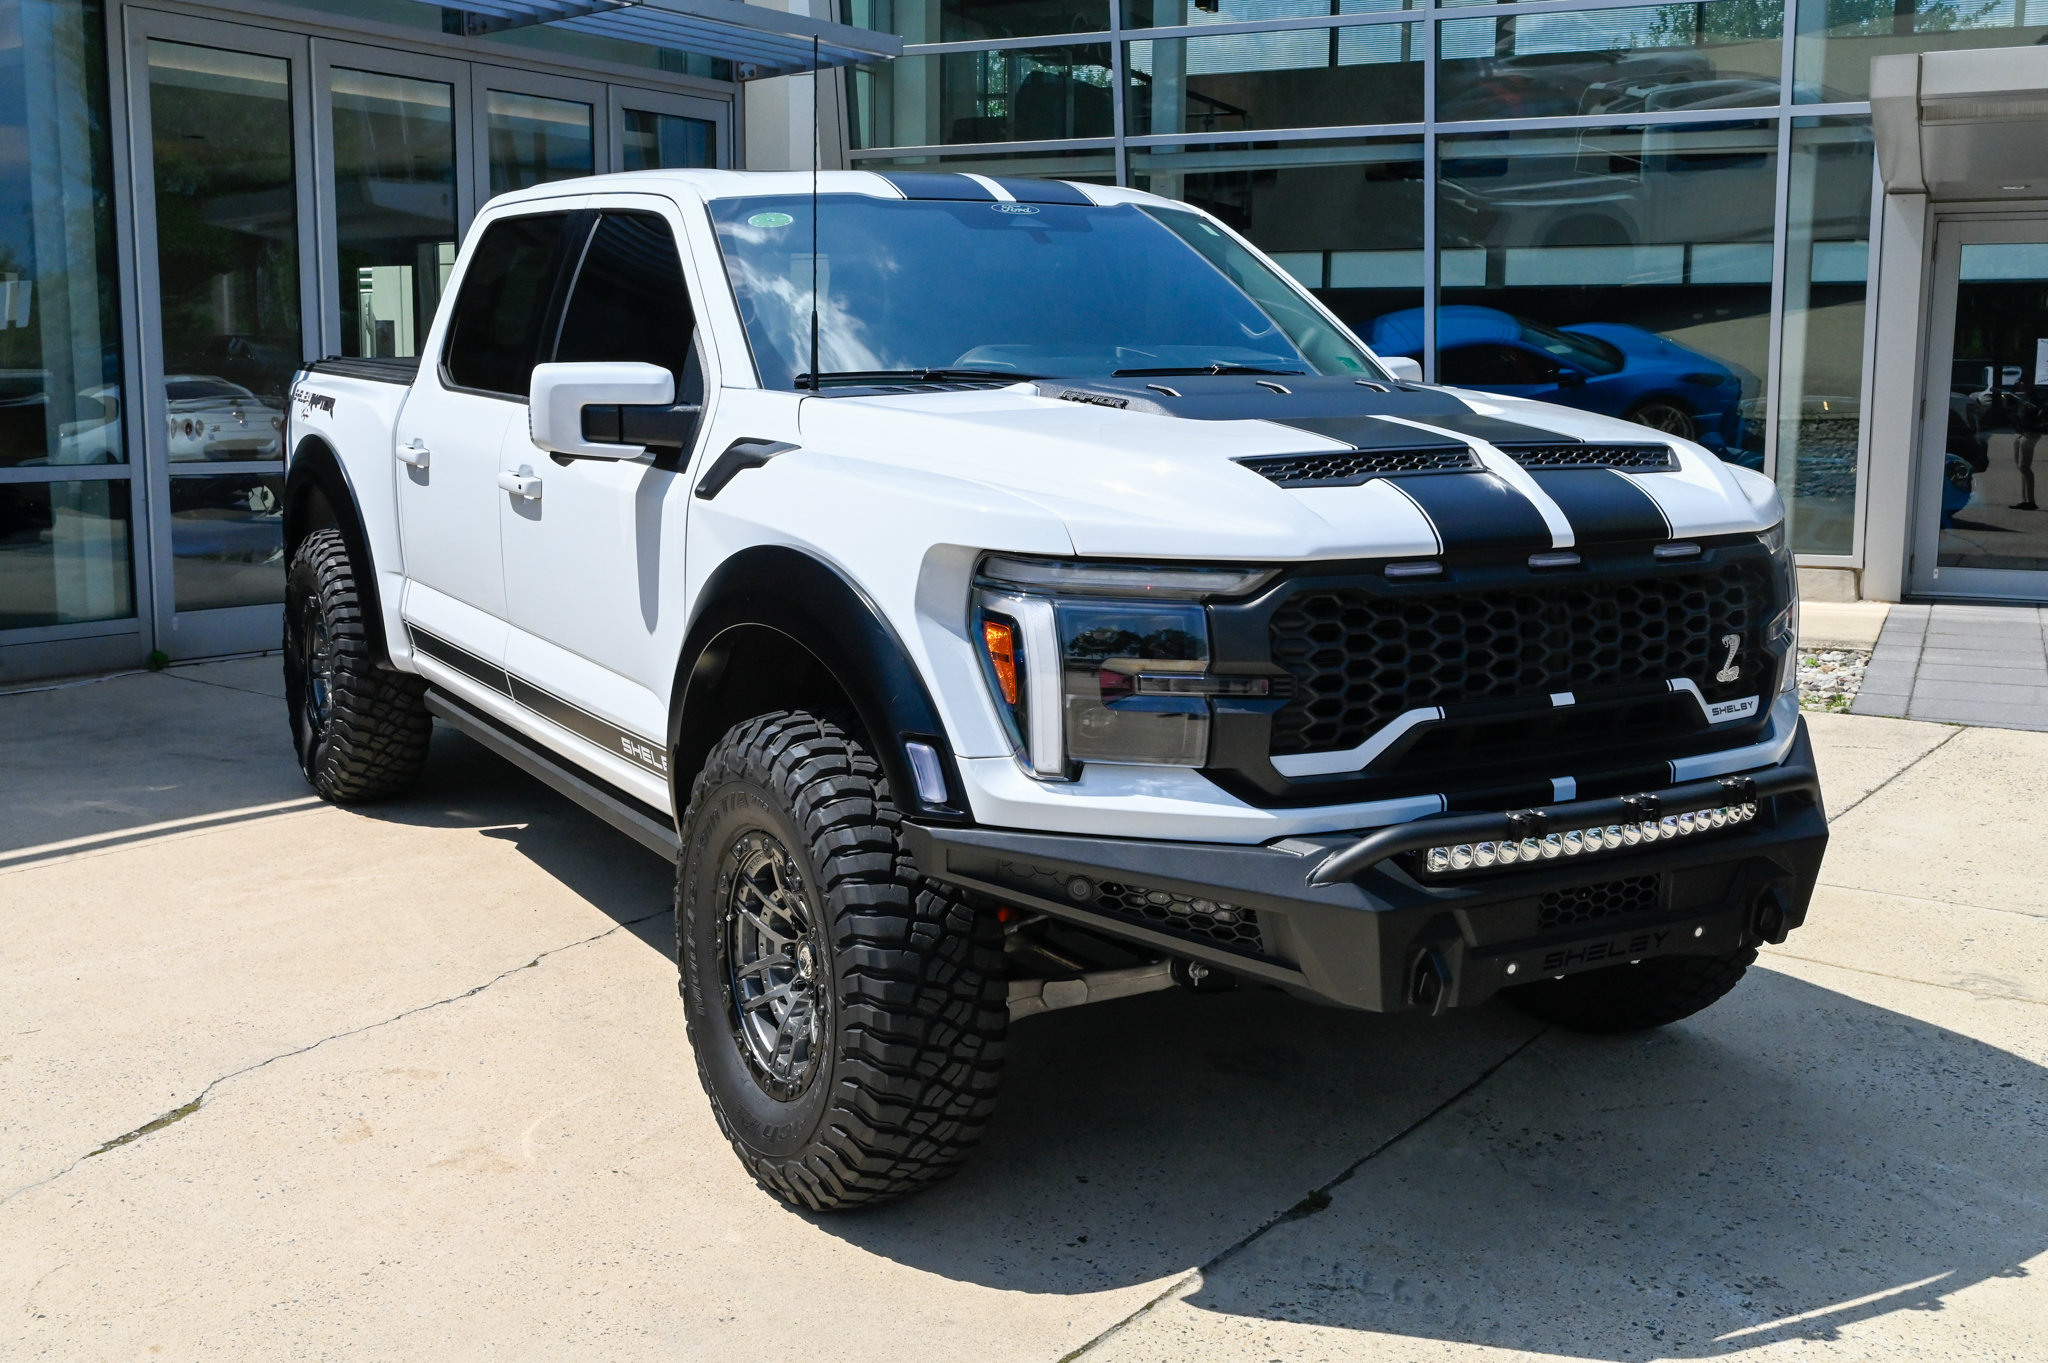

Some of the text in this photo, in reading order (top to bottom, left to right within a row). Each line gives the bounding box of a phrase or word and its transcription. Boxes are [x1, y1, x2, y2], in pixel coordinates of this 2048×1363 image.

[1001, 204, 1032, 213] Ford
[1060, 390, 1129, 410] RAPTOR
[1712, 701, 1754, 717] SHELBY
[1542, 929, 1671, 970] SHELBY
